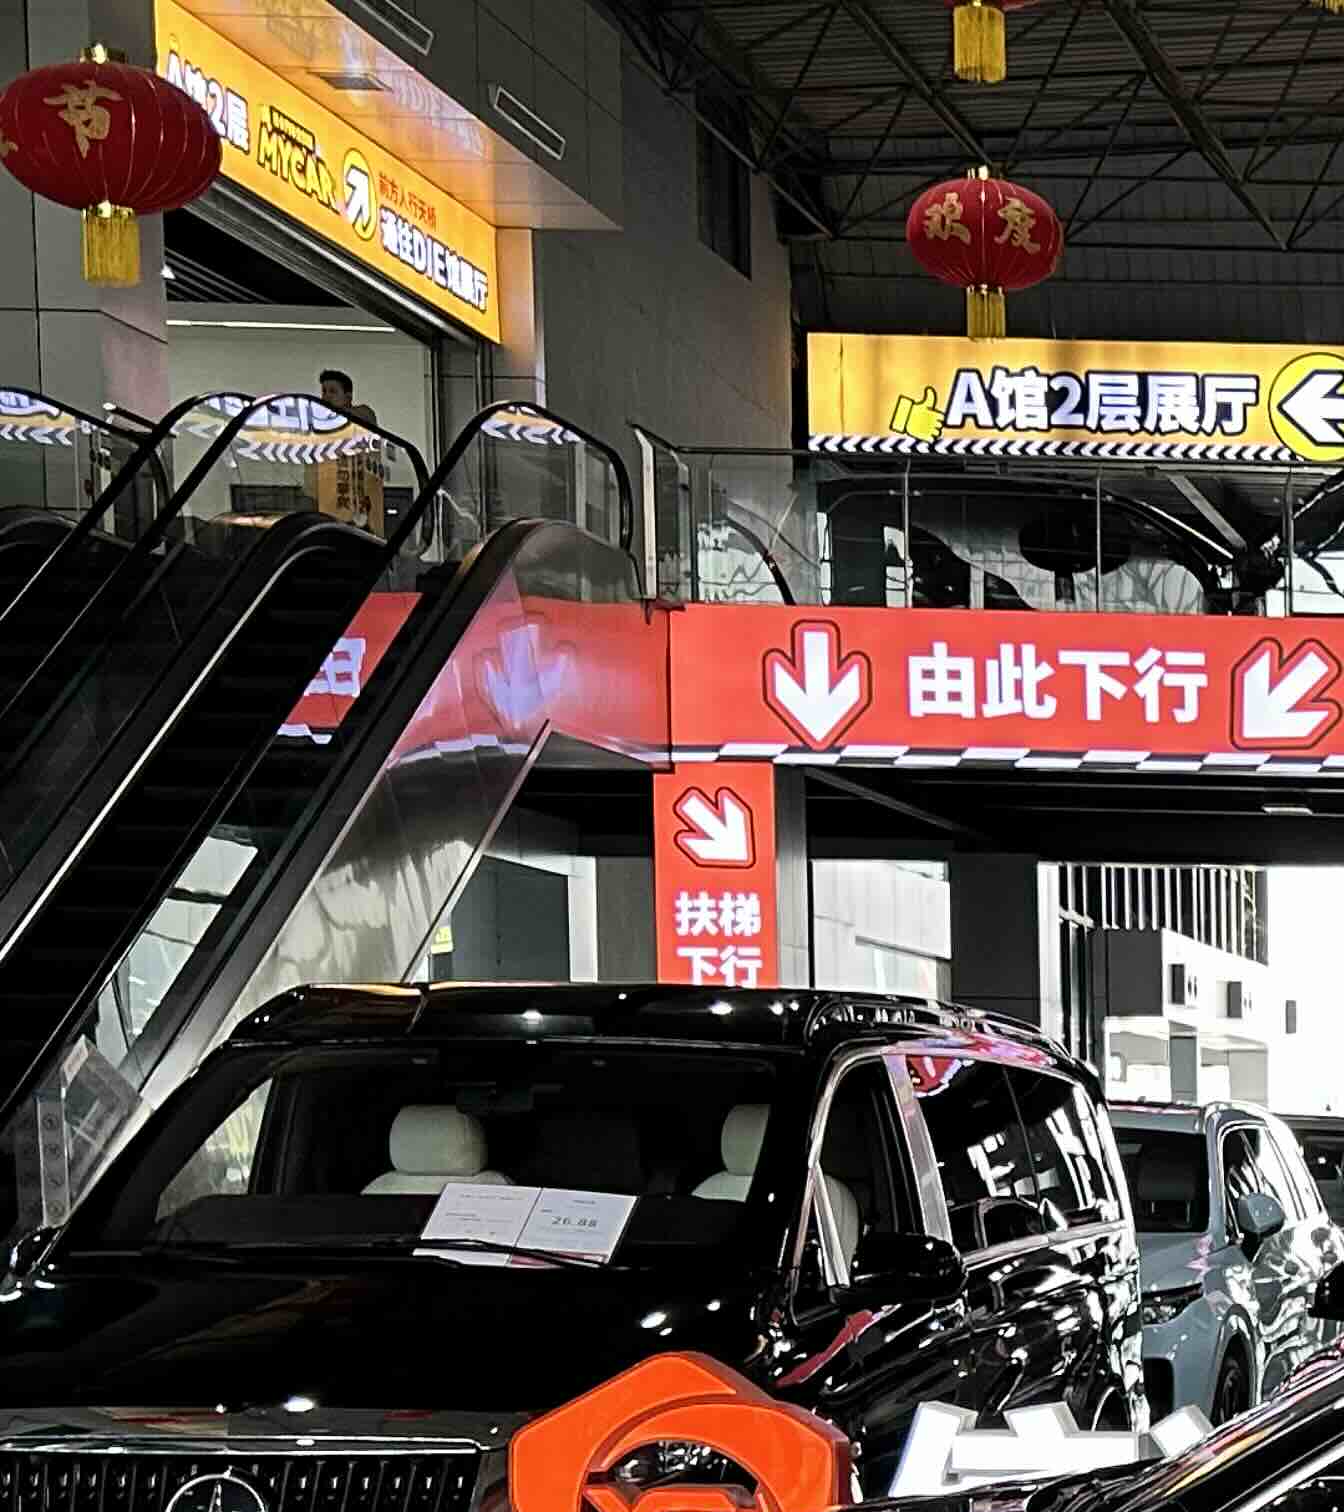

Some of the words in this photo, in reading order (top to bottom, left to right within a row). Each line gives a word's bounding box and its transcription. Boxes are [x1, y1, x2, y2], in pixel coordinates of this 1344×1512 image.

[946, 368, 1259, 435] A馆2层展厅
[907, 642, 1209, 724] 由此下行
[674, 891, 761, 938] 扶梯
[676, 946, 763, 987] 下行
